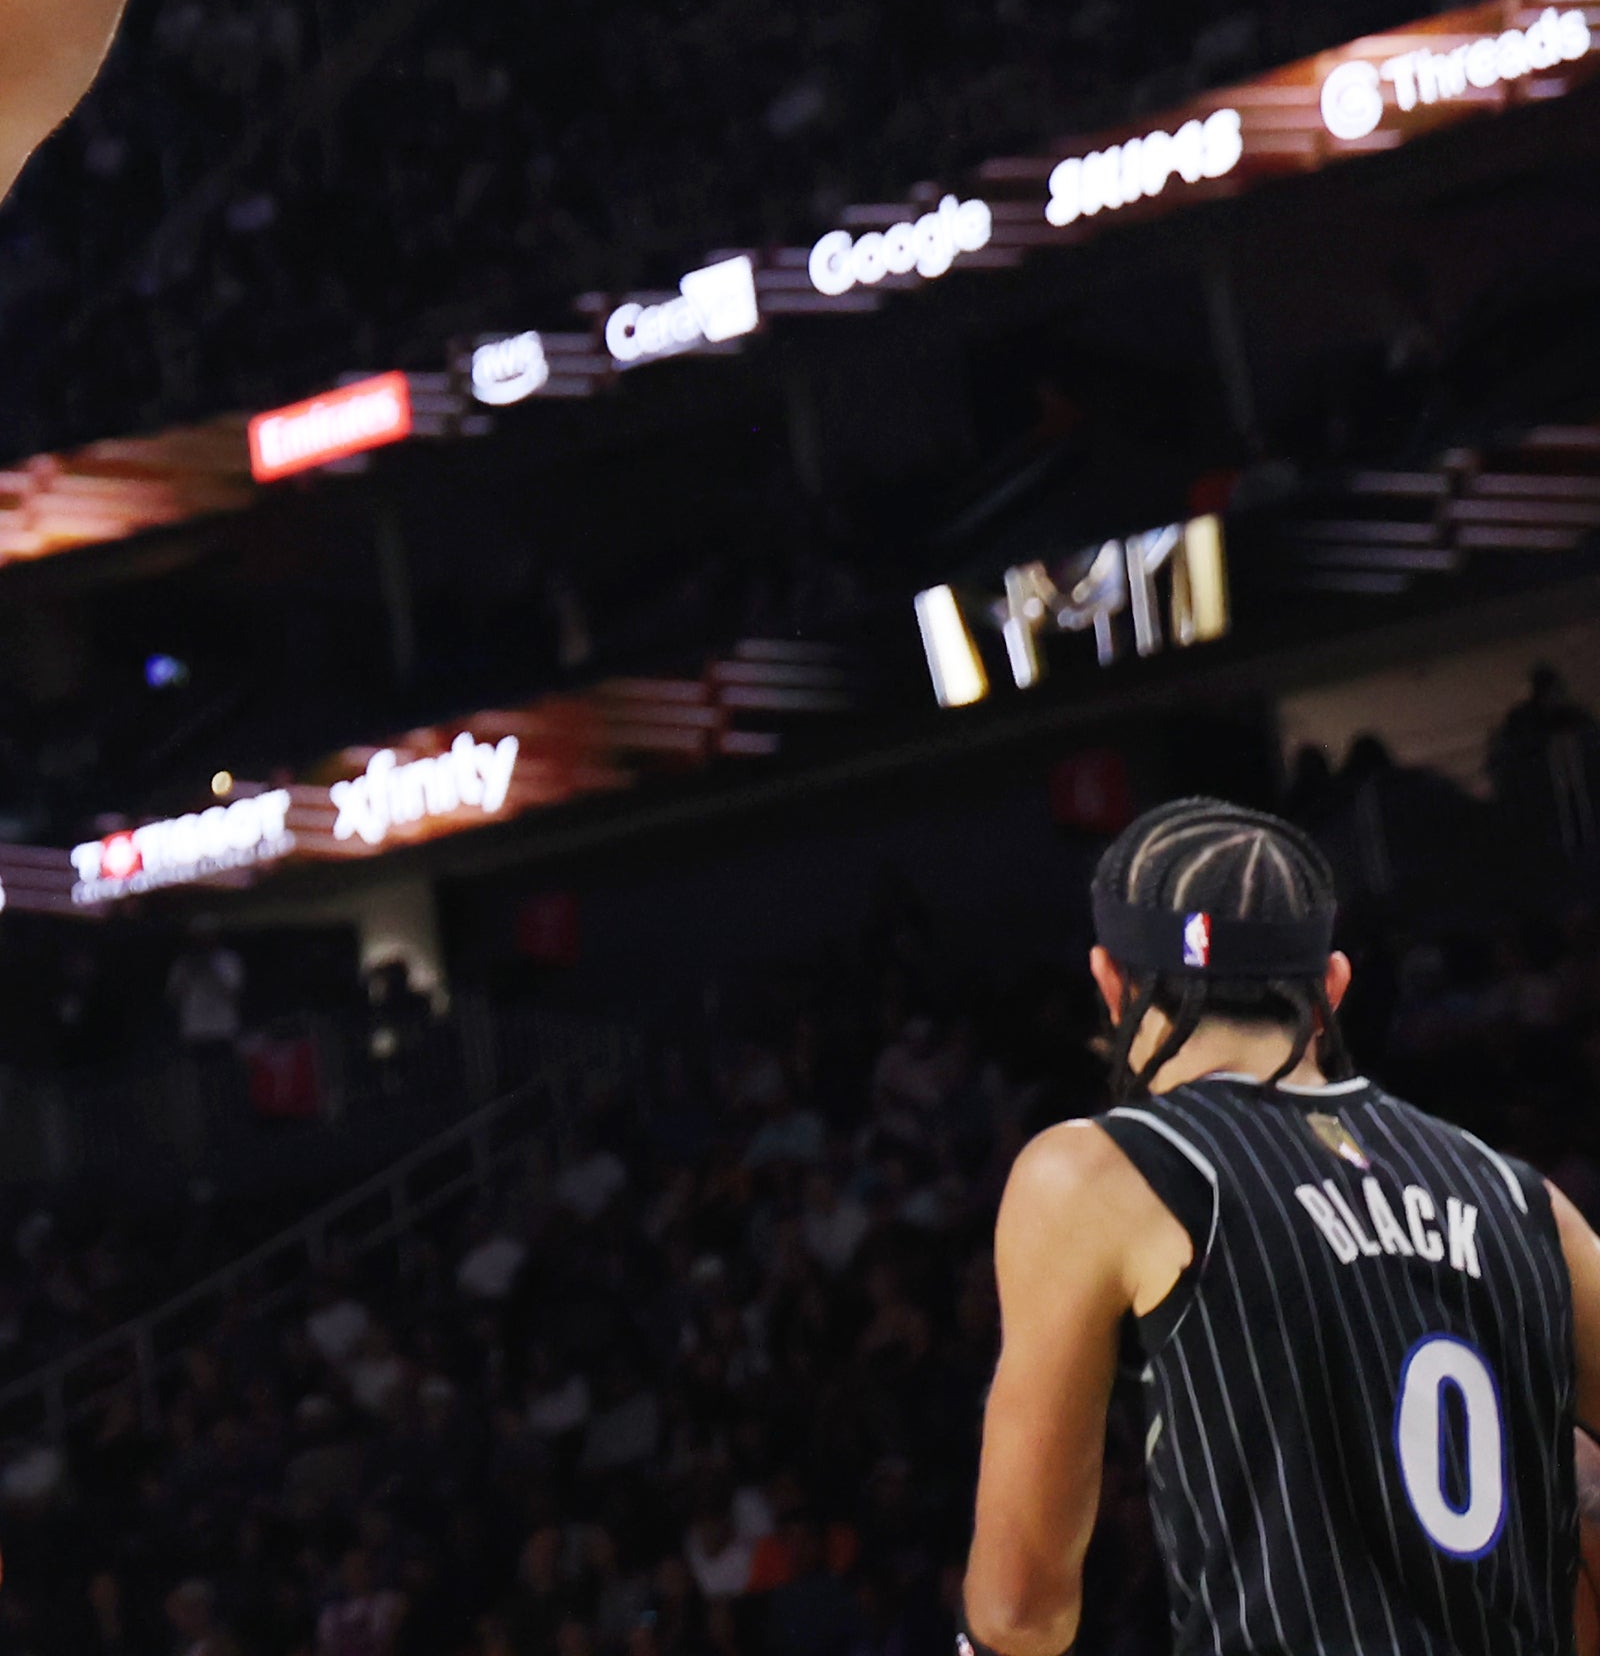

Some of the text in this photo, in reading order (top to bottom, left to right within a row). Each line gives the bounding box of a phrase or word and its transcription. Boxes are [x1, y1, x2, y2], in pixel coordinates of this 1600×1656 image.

[808, 193, 992, 296] Google
[1379, 6, 1592, 112] Threads
[329, 732, 519, 844] xfinity
[1294, 1175, 1482, 1280] BLACK
[1392, 1328, 1508, 1561] 0
